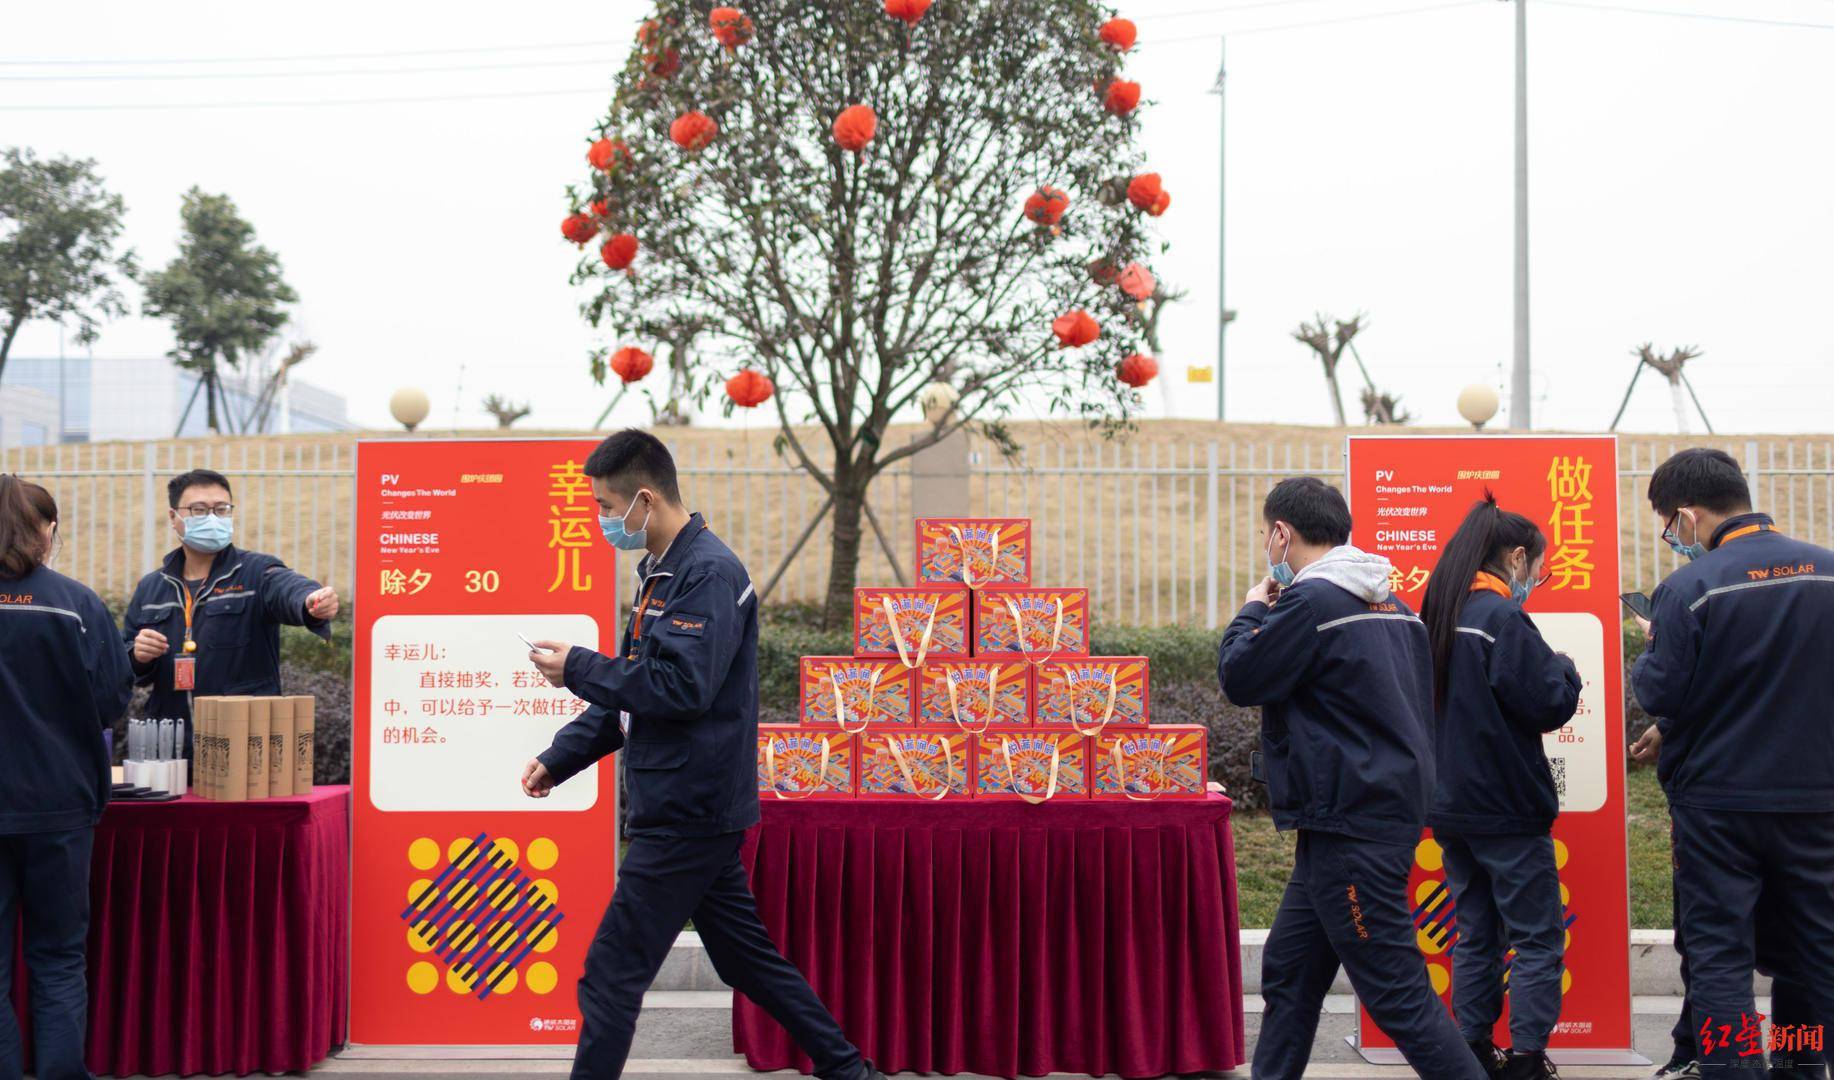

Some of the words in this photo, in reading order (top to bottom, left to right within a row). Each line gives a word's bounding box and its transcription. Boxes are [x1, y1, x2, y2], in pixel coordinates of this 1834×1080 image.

[381, 474, 399, 485] PV
[1376, 470, 1394, 481] PV
[381, 489, 416, 498] Changes
[417, 489, 431, 497] The
[432, 489, 456, 497] World
[1376, 485, 1411, 494] Changes
[1412, 485, 1427, 493] The
[1428, 485, 1452, 493] World
[548, 460, 592, 593] 幸运儿
[1547, 456, 1594, 591] 做任务
[380, 534, 439, 545] CHINESE
[1376, 530, 1436, 541] CHINESE
[1748, 569, 1769, 580] TW
[1773, 564, 1814, 577] SOLAR
[380, 569, 432, 595] 除夕
[465, 570, 499, 593] 30
[419, 671, 553, 689] 直接抽奖，若没
[383, 727, 448, 744] 的机会。
[1352, 905, 1368, 938] SOLAR
